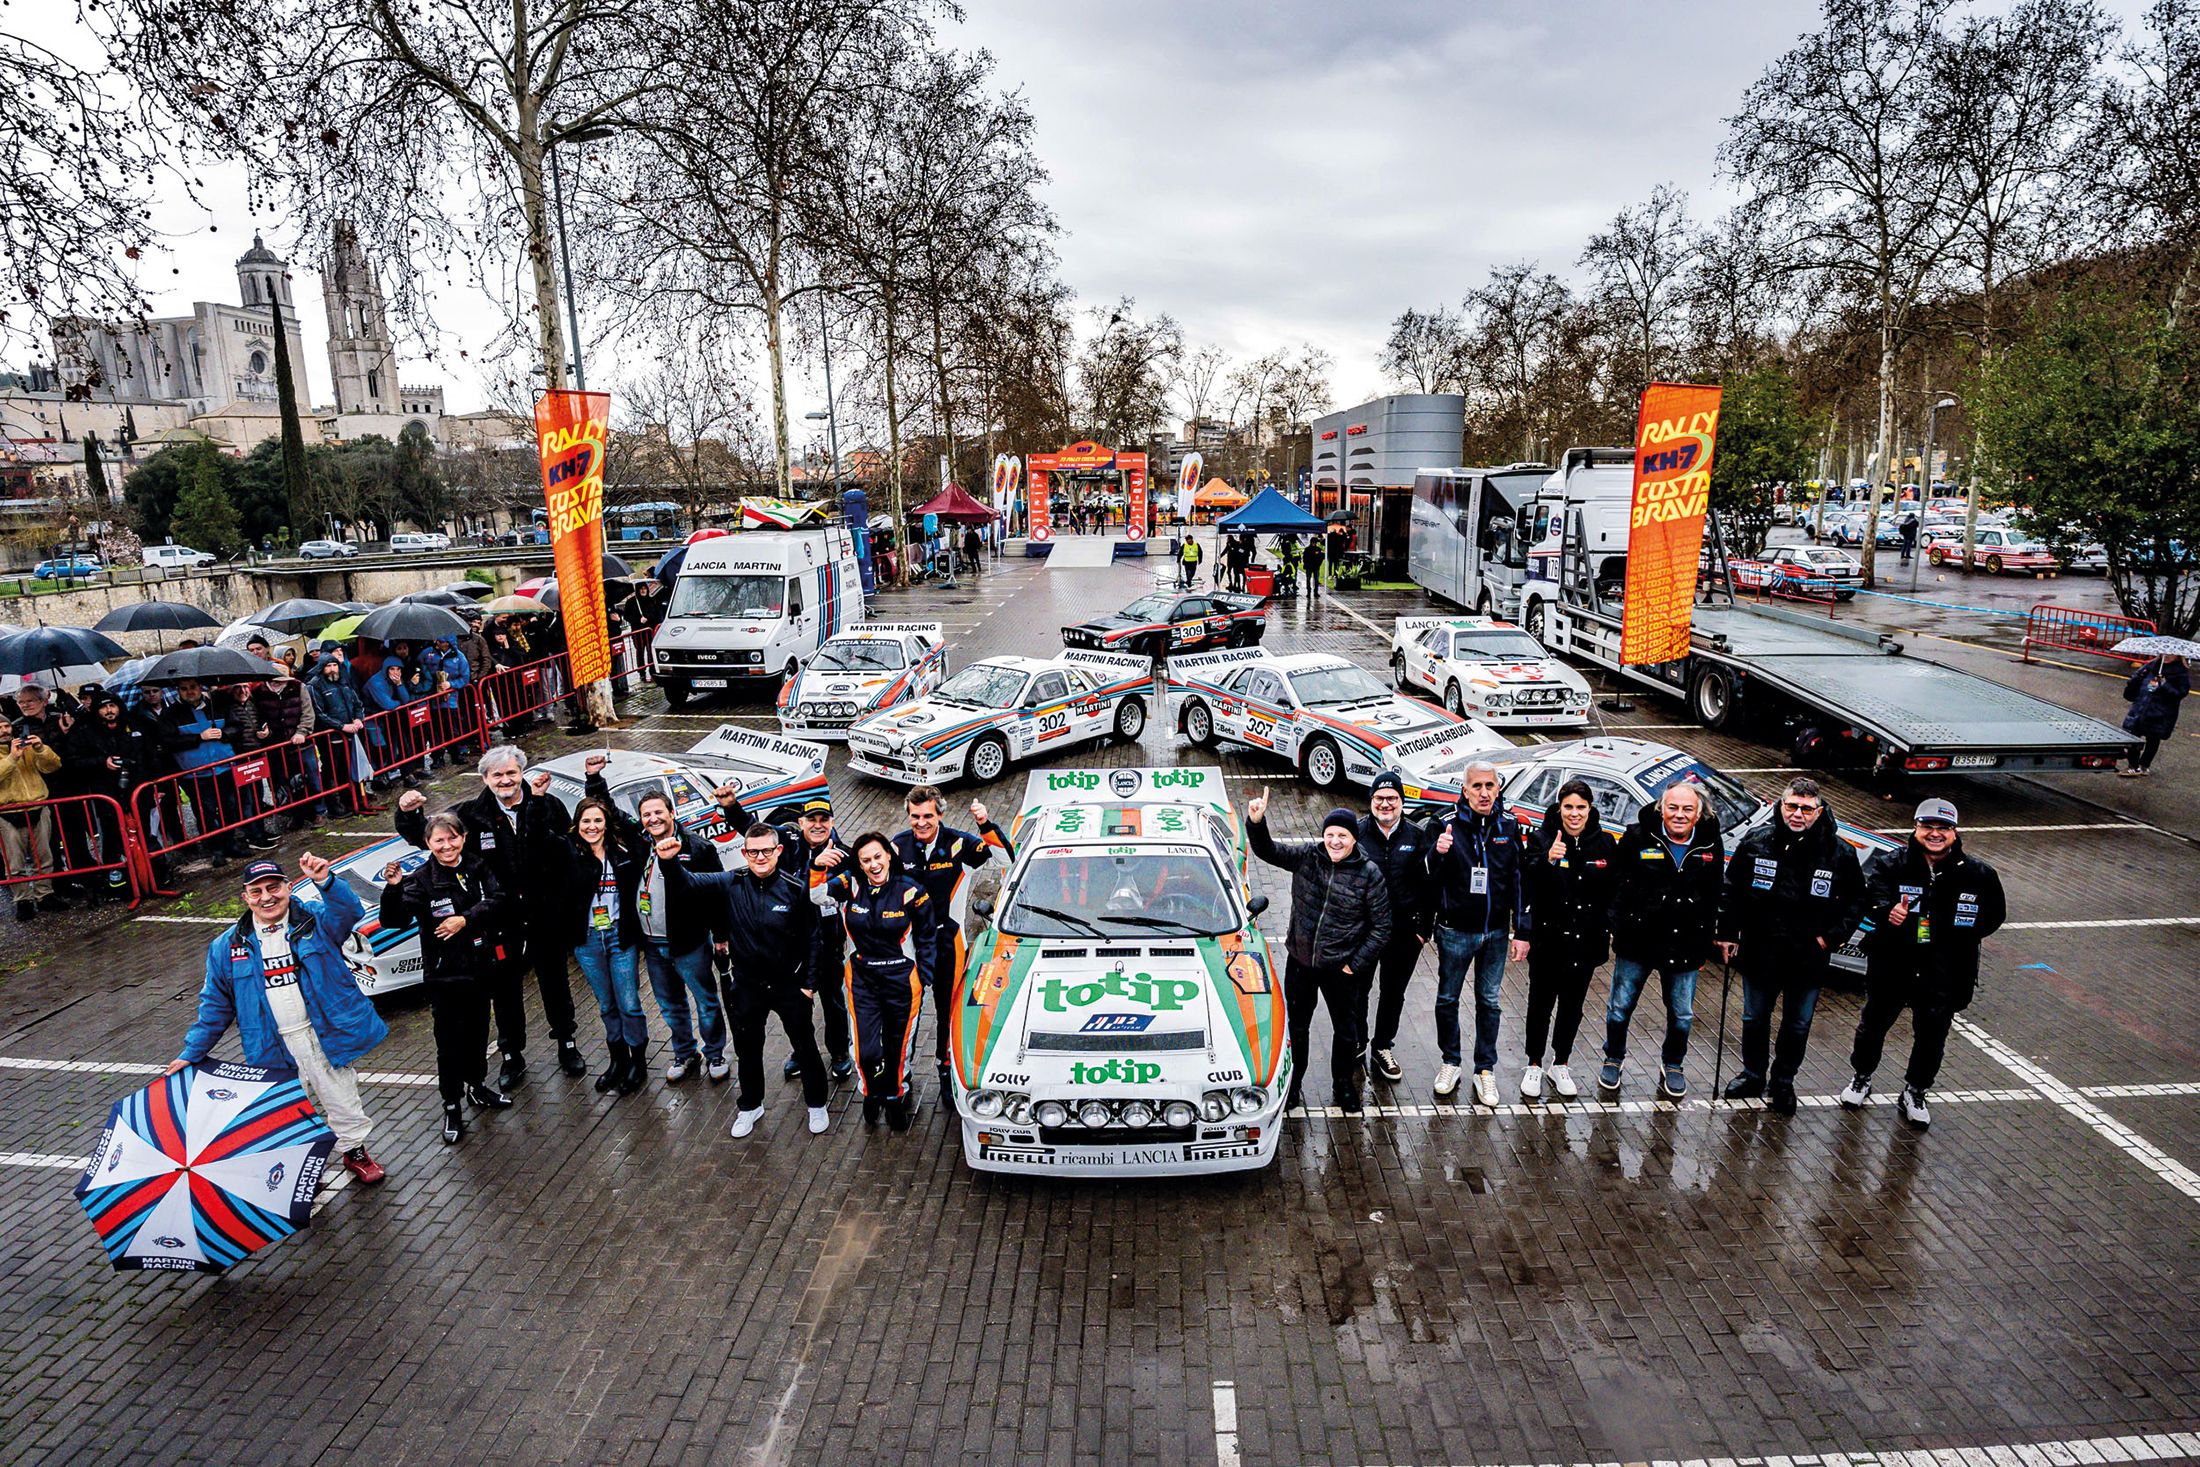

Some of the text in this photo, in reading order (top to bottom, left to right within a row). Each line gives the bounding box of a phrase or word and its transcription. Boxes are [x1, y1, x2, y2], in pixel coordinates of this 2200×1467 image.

[542, 416, 608, 459] RALLY
[1640, 410, 1718, 448] RALLY
[1637, 470, 1711, 504] COSTA
[550, 475, 603, 518] COSTA
[1632, 493, 1709, 529] BRAVA
[552, 497, 603, 545] BRAVA
[687, 562, 782, 571] LANCIA MARTINI
[850, 624, 894, 632] MARTINI
[1183, 626, 1203, 638] 309
[1405, 621, 1441, 629] LANCIA
[1064, 651, 1146, 668] MARTINI RACING
[1174, 650, 1264, 669] MARTINI RACING
[1427, 660, 1437, 675] 26
[1076, 700, 1111, 714] MARTINI
[1212, 699, 1242, 716] MARTINI
[1039, 712, 1066, 733] 302
[1220, 724, 1236, 736] Beta
[1246, 718, 1275, 738] 307
[719, 728, 819, 759] MARTINI RACING
[849, 734, 867, 745] LANCIA
[1955, 756, 1978, 765] 8356
[1047, 771, 1101, 791] totip
[1151, 769, 1205, 788] totip
[1639, 764, 1672, 788] LANCIA
[1056, 809, 1086, 834] totip
[1157, 808, 1187, 833] totip
[1107, 847, 1137, 855] totip
[1168, 847, 1199, 855] LANCIA
[937, 862, 953, 870] Beta
[263, 957, 294, 971] ARTI
[1037, 972, 1199, 1012] totip
[213, 1068, 264, 1080] MARTINI
[219, 1063, 268, 1075] RACING
[1070, 1058, 1162, 1085] totip
[1207, 1070, 1244, 1083] CLUB
[989, 1073, 1030, 1086] JOLLY
[980, 1145, 1055, 1164] PIRELLI
[1061, 1150, 1178, 1165] ricambi LANCIA
[1183, 1142, 1259, 1161] PIRELLI
[294, 1156, 317, 1202] MARTINI
[304, 1158, 326, 1202] RACING
[142, 1257, 195, 1266] MARTINI
